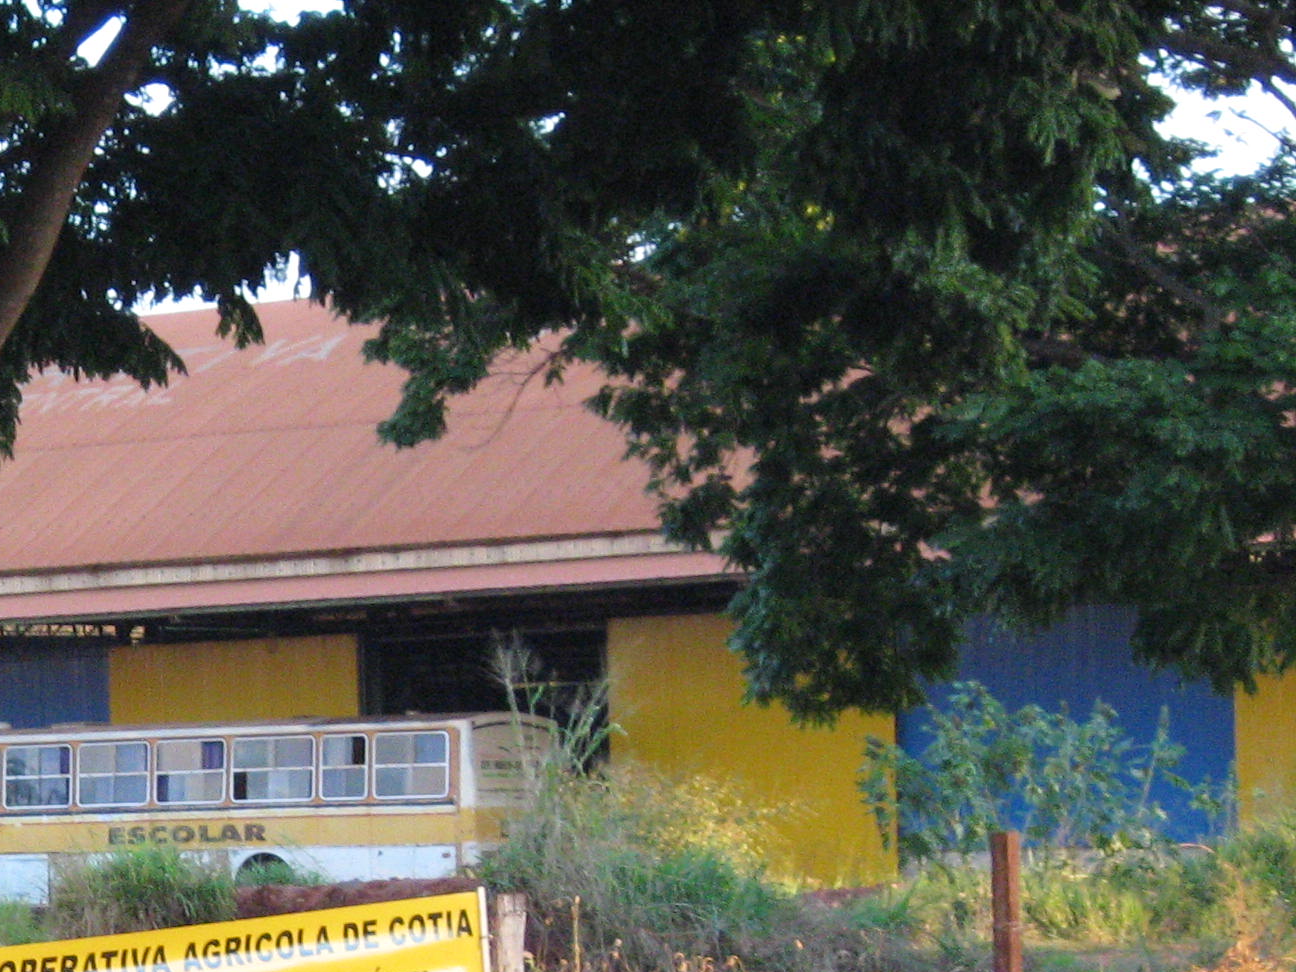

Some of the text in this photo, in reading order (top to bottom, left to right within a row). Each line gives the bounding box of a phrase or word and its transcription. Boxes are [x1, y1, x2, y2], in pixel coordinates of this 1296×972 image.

[108, 823, 266, 845] ESCOLAR
[184, 925, 335, 972] AGRICOLA
[342, 920, 380, 952] DE
[389, 909, 473, 946] COTIA
